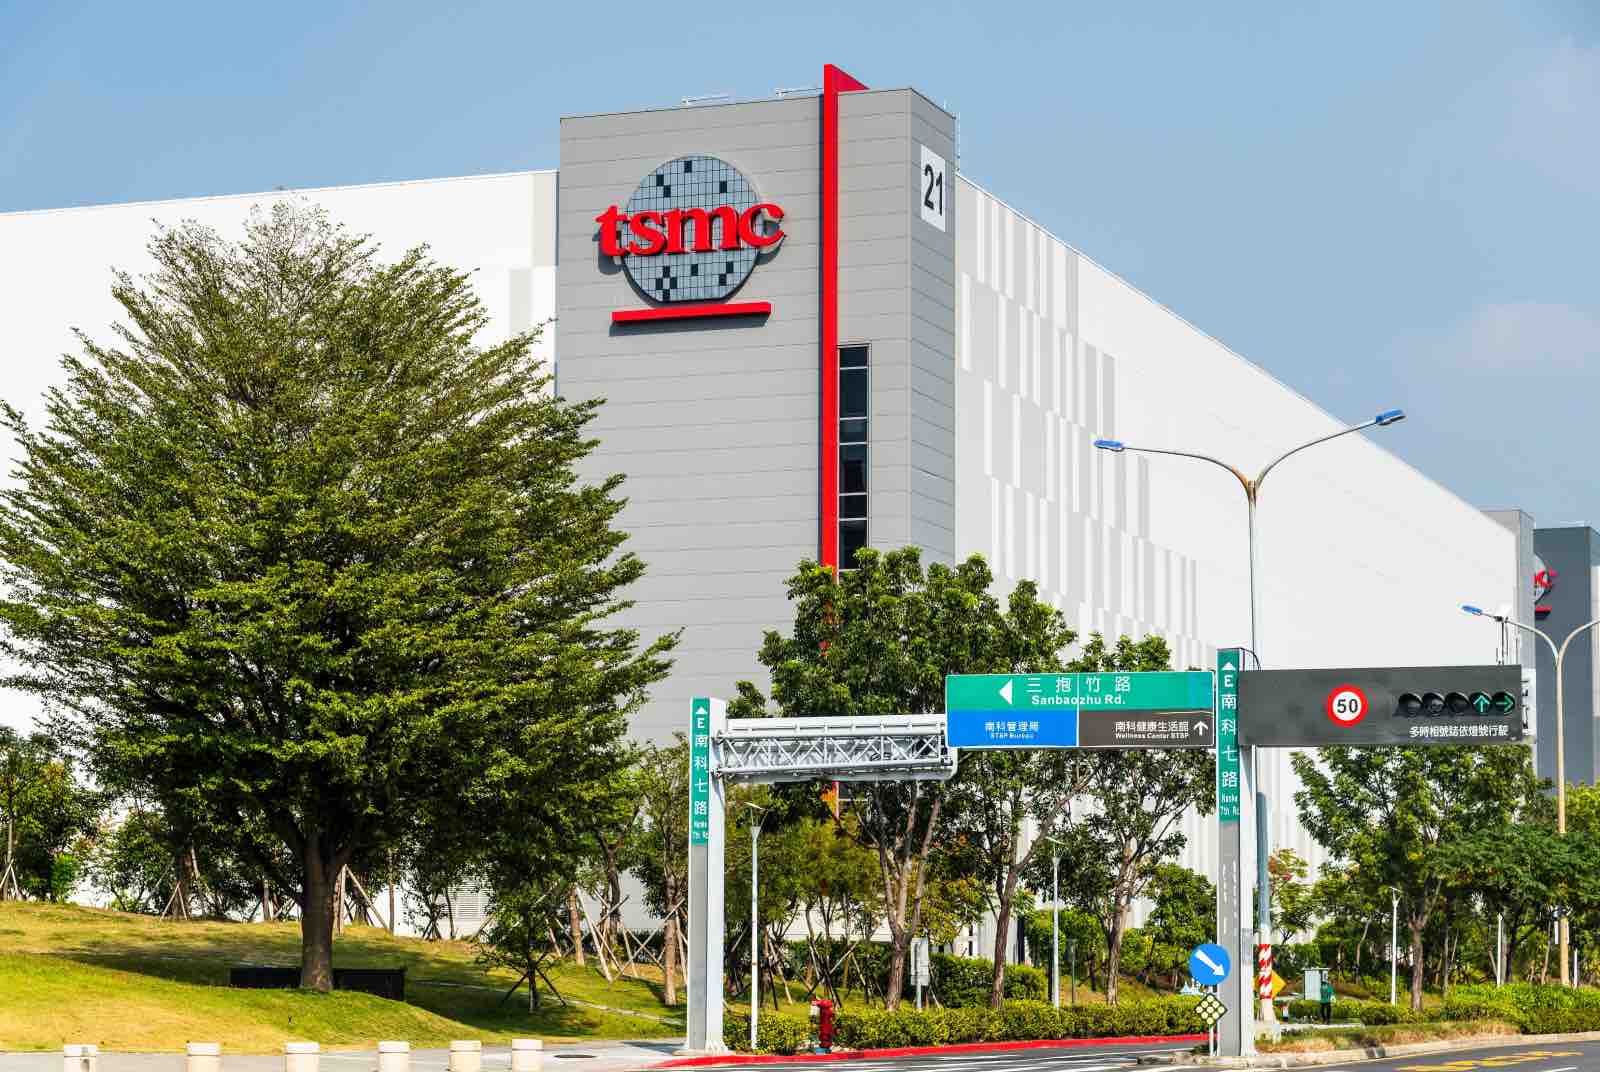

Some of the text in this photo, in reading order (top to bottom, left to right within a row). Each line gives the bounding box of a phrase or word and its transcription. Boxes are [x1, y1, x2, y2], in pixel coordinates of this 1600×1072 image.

[924, 164, 943, 216] 21
[595, 203, 785, 256] tsmc
[1025, 675, 1131, 693] 三抱竹路
[1224, 675, 1233, 688] E
[1031, 693, 1126, 705] Sanbaozhu Rd.
[1337, 698, 1358, 714] 50
[697, 717, 705, 729] E
[1221, 694, 1237, 788] 南科七路
[694, 734, 707, 815] 南科七路
